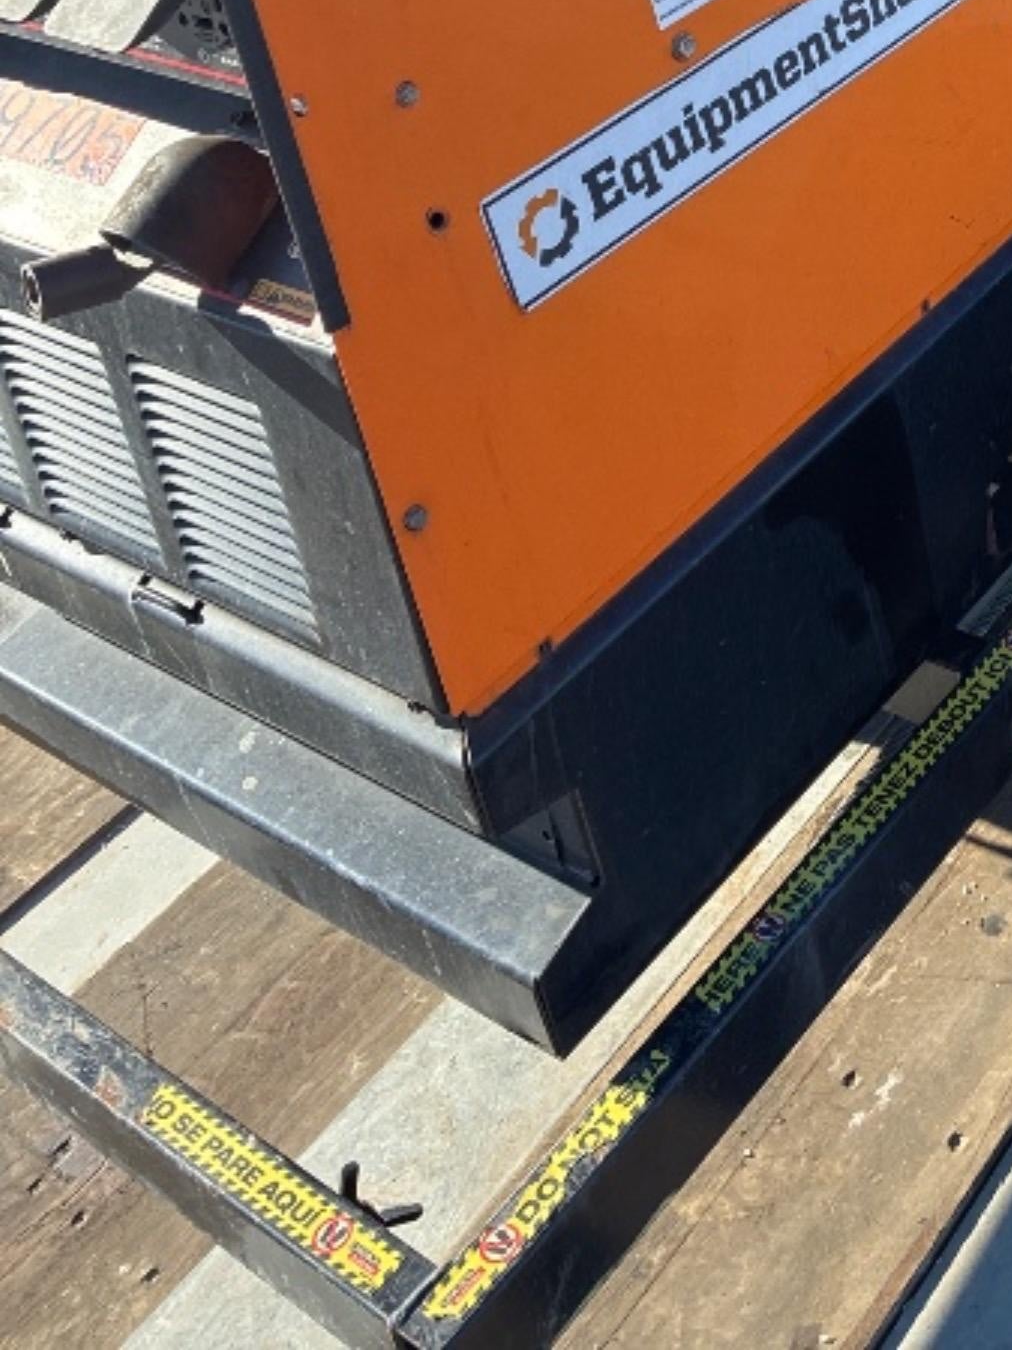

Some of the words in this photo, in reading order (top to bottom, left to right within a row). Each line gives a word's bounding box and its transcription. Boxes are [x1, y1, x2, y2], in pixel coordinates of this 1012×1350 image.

[851, 762, 913, 828] TENEZ
[912, 681, 987, 760] DEBOUT
[171, 1113, 204, 1145] SE
[204, 1137, 264, 1185] PARE
[261, 1182, 323, 1228] AQUÍ
[515, 1176, 558, 1223] DO
